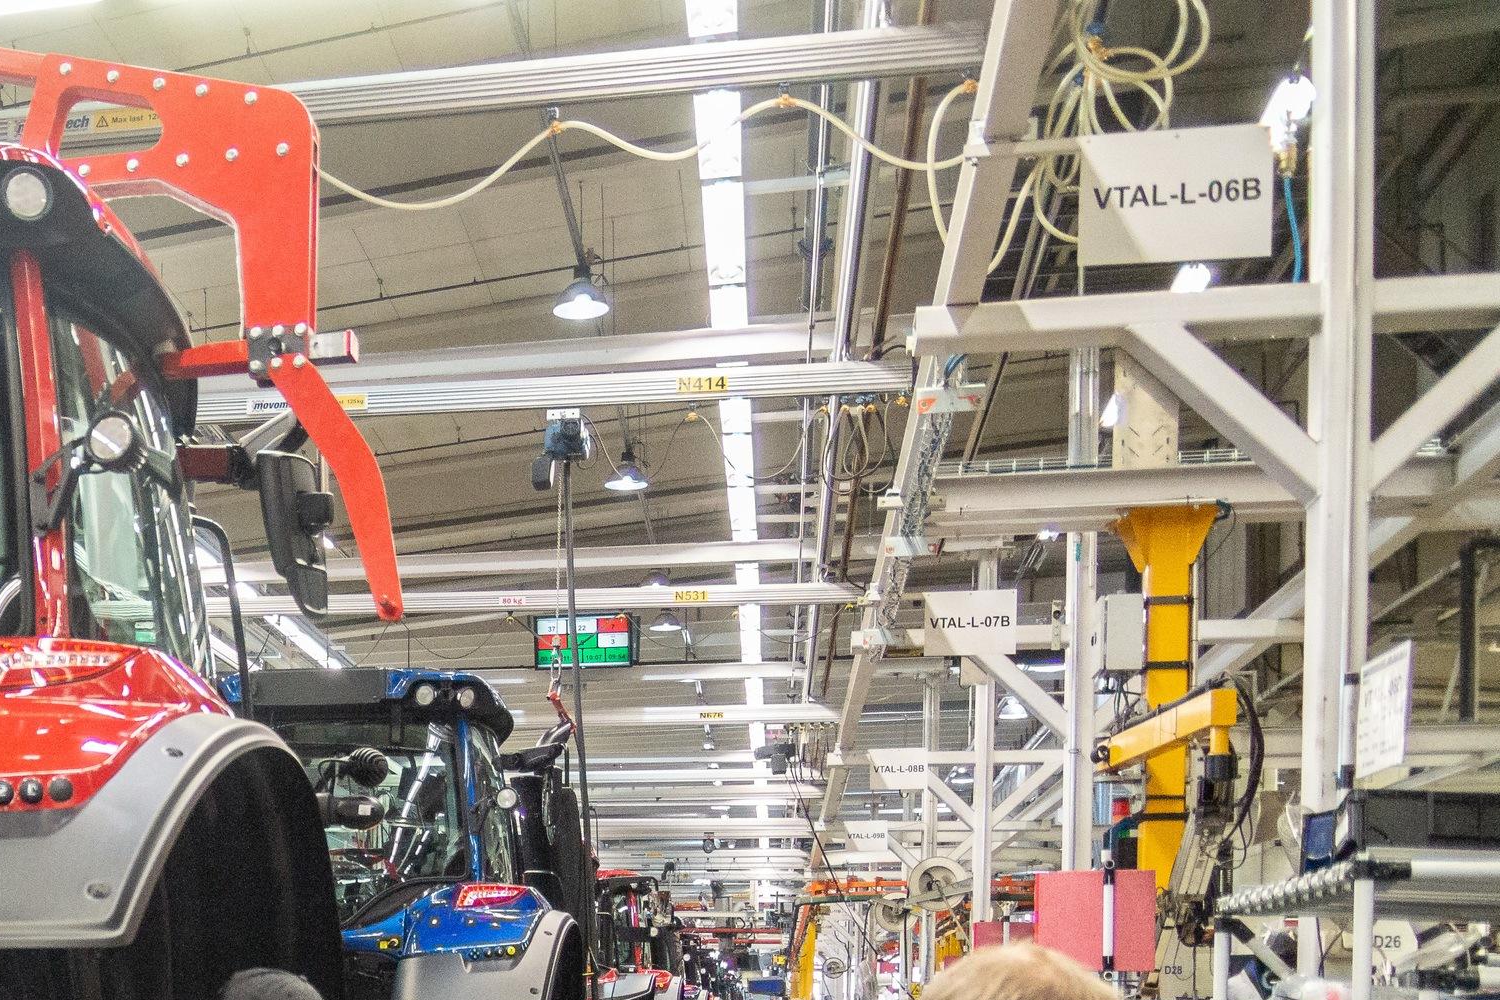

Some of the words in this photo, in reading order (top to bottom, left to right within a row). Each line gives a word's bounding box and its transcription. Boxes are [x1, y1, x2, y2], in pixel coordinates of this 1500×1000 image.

[111, 115, 128, 124] Max
[129, 113, 144, 122] last
[1093, 177, 1262, 210] VTAL-L-06B
[678, 376, 726, 391] N414
[513, 597, 522, 605] kg
[674, 591, 707, 601] N531
[930, 615, 1010, 629] VTAL-L-07B
[873, 764, 925, 773] VTAL-L-08B
[1164, 965, 1183, 975] D28
